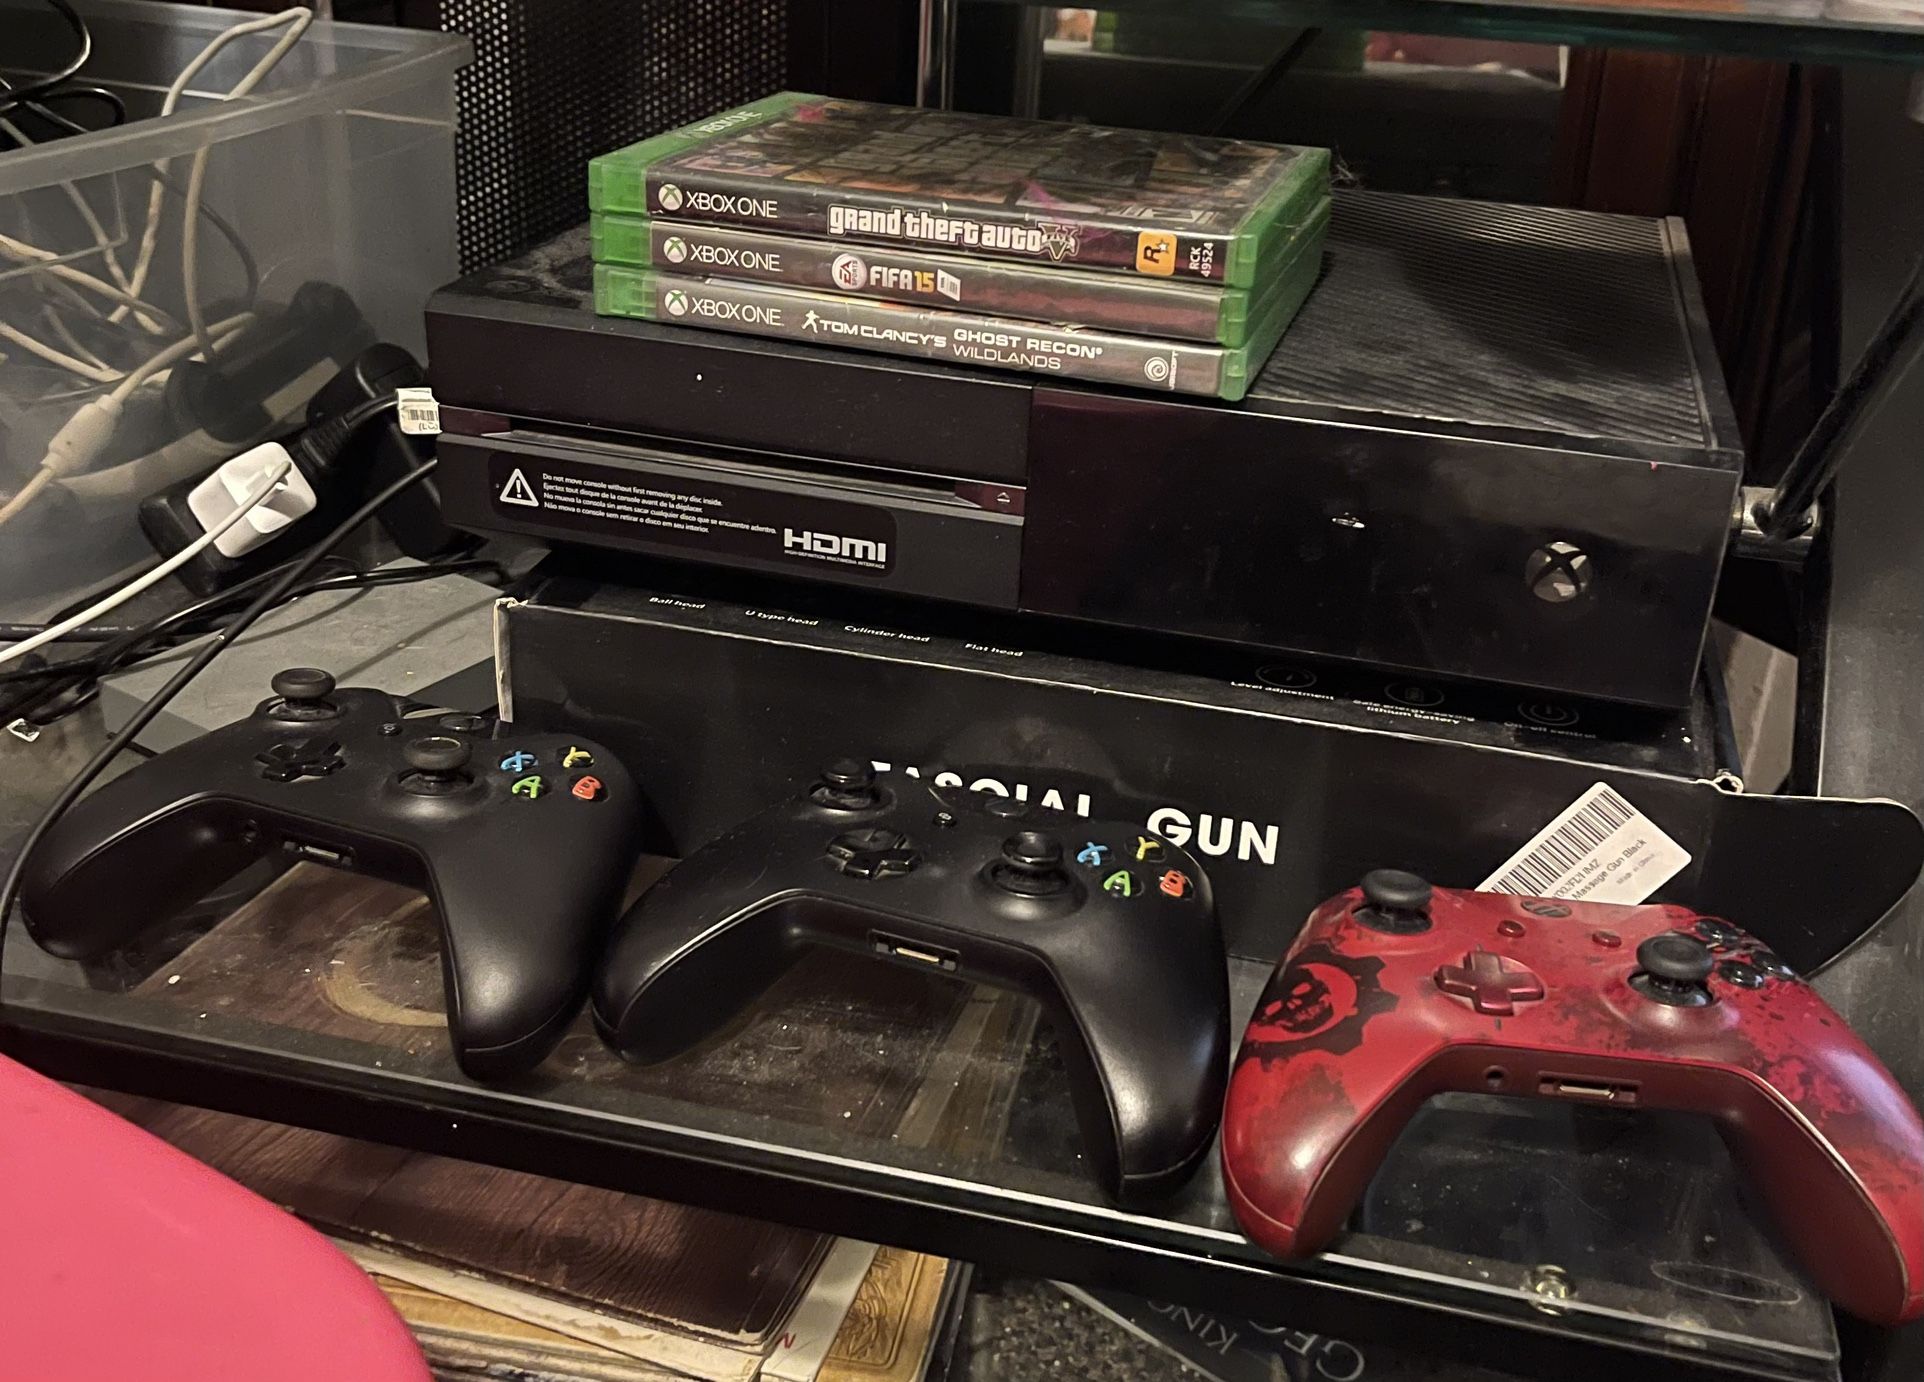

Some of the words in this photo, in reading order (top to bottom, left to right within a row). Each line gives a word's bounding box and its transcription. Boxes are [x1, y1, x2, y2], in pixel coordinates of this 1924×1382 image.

[686, 191, 735, 214] XBOX
[737, 197, 778, 218] ONE
[829, 206, 901, 235] grand
[904, 211, 979, 244] theft
[981, 223, 1042, 251] auto
[691, 244, 739, 267] XBOX
[741, 251, 782, 272] ONE
[1189, 246, 1201, 270] RCK
[1200, 242, 1213, 278] 49524
[839, 260, 852, 286] EA
[870, 265, 913, 291] FIFA
[914, 270, 935, 293] 15
[692, 297, 740, 320] XBOX
[742, 305, 783, 326] ONE
[819, 319, 859, 336] TOM
[860, 325, 947, 348] CLANCY'S
[954, 328, 1021, 348] GHOST
[953, 344, 1061, 370] WILDLANDS
[565, 477, 582, 485] move
[583, 480, 607, 489] console
[608, 484, 632, 493] without
[633, 486, 645, 495] first
[646, 489, 676, 501] removing
[677, 494, 689, 502] any
[689, 495, 702, 503] disc
[580, 488, 600, 497] disque
[617, 495, 640, 504] console
[543, 492, 553, 500] No
[582, 499, 606, 508] consola
[680, 513, 696, 521] disco
[697, 516, 709, 524] que
[645, 517, 661, 526] disco
[784, 527, 887, 562] HDMI
[649, 597, 673, 605] Ball
[674, 600, 706, 609] head
[757, 612, 786, 621] type
[787, 615, 819, 626] head
[844, 625, 896, 637] Cylinder
[898, 633, 930, 642] head
[964, 643, 989, 652] Flat
[990, 647, 1024, 657] head
[1264, 687, 1334, 700] adjustment
[1366, 706, 1412, 717] lithium
[1413, 713, 1460, 724] battery
[511, 775, 542, 799] A
[571, 775, 602, 800] B
[1136, 836, 1161, 861] Y
[1147, 807, 1279, 865] GUN
[1077, 841, 1109, 866] X
[1571, 870, 1609, 900] Massage
[1606, 857, 1626, 872] Gun
[1622, 839, 1648, 859] Black
[1103, 869, 1131, 897] A
[1159, 869, 1186, 897] B
